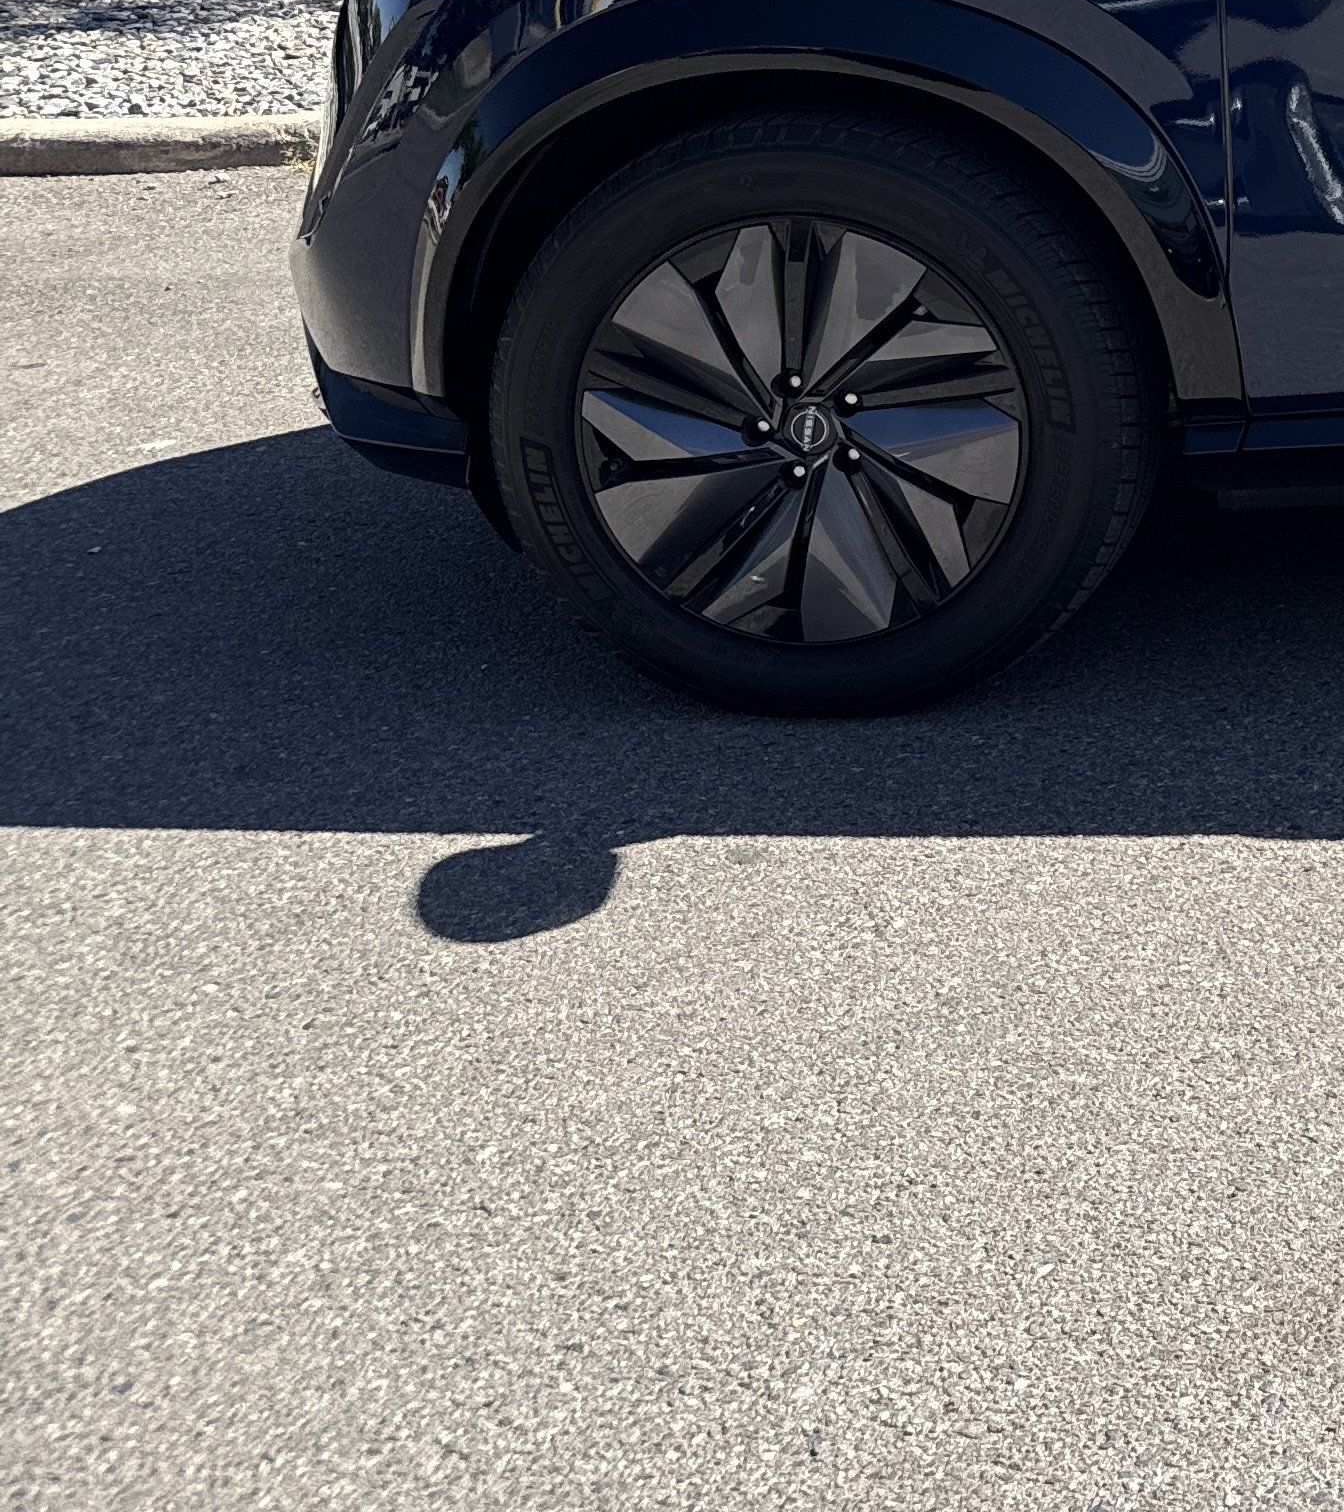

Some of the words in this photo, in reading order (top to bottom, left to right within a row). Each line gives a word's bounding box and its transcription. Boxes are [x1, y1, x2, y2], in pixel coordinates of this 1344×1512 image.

[986, 268, 1074, 426] MICHELIN
[802, 405, 817, 452] NISSAN
[523, 445, 614, 604] MICHELIN
